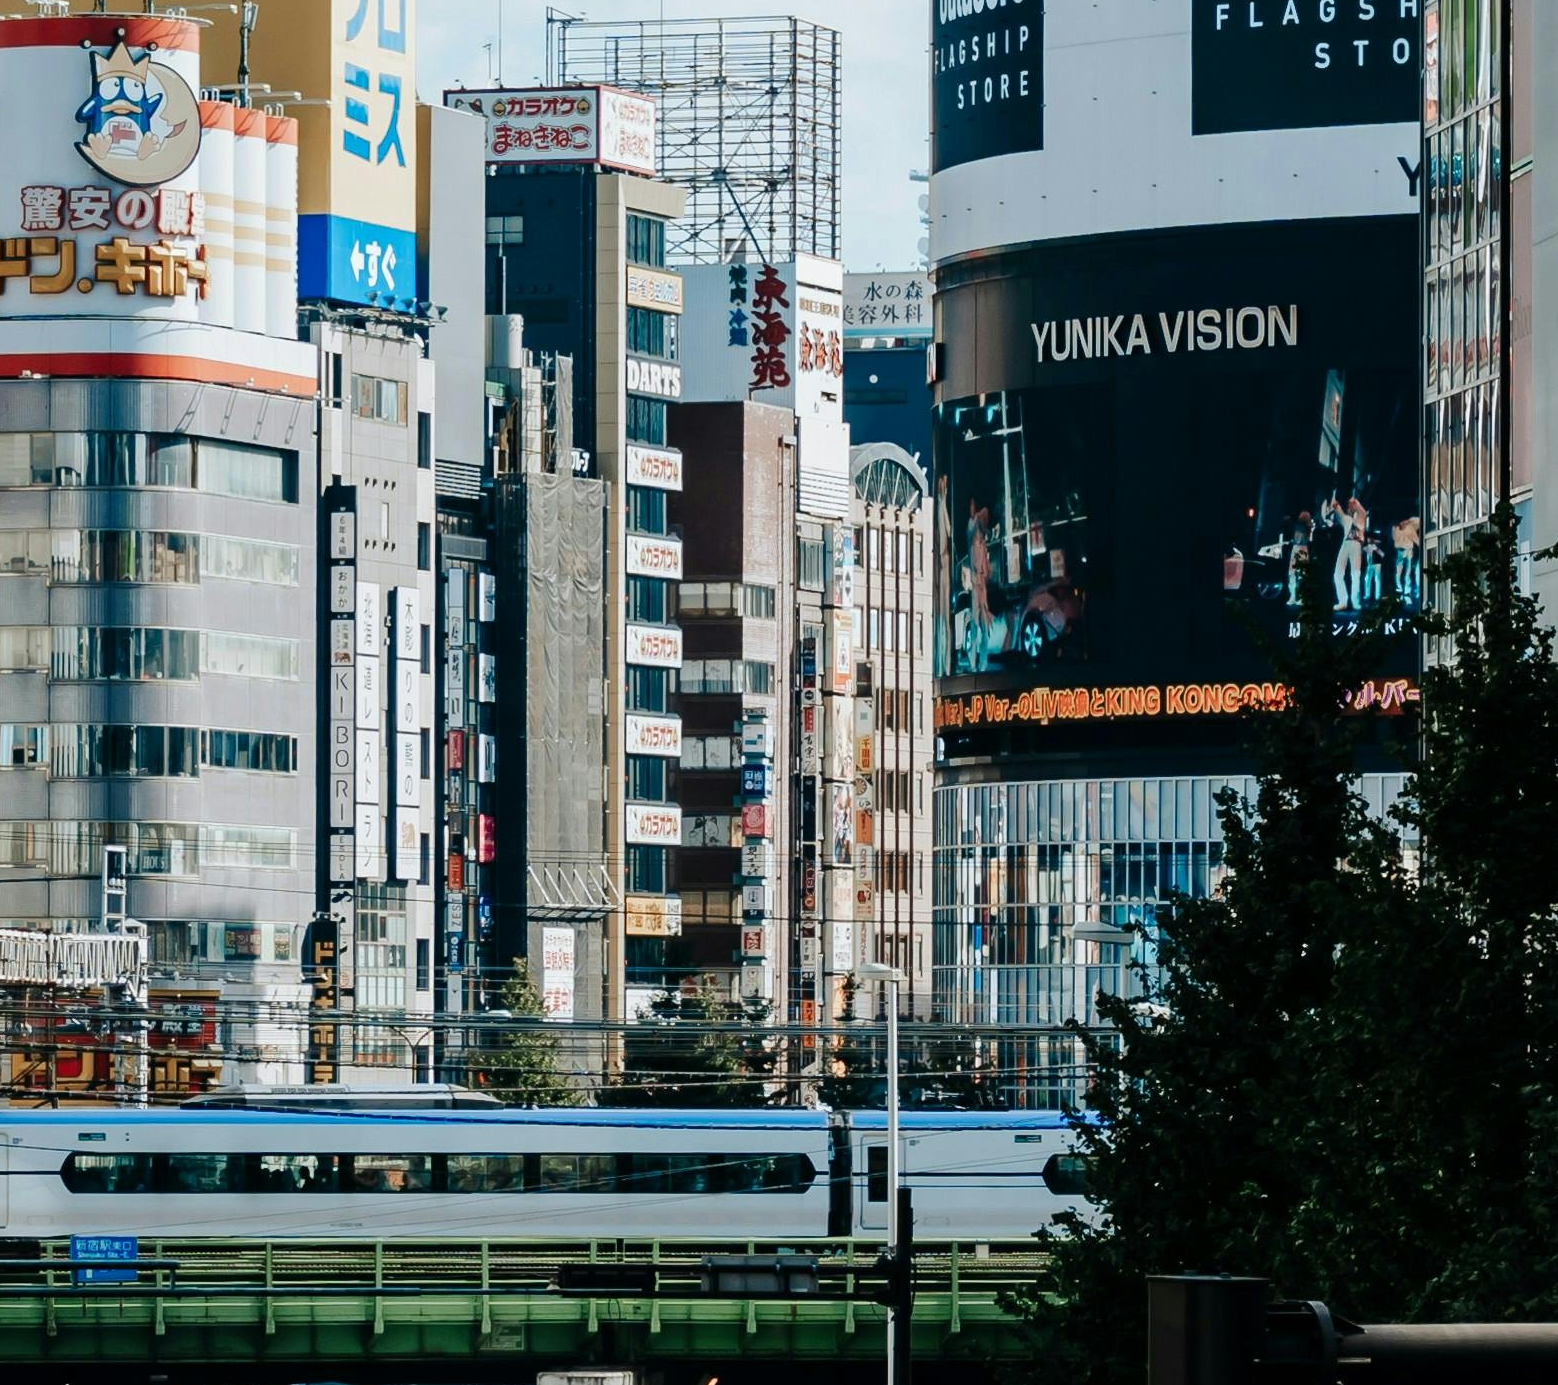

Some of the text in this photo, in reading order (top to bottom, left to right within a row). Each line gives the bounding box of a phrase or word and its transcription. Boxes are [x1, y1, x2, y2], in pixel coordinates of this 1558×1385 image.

[934, 26, 1031, 76] FLAGSHIP
[1314, 37, 1410, 69] STO
[506, 97, 577, 117] カラオケ
[956, 75, 1030, 111] STORE
[343, 63, 406, 168] ミス
[492, 121, 591, 155] まねきねこ
[364, 239, 397, 293] すぐ
[864, 280, 924, 300] 水の森
[749, 263, 792, 388] 東海苑
[843, 305, 924, 325] 美容外科
[1031, 304, 1298, 363] YUNIKA VISION
[626, 358, 682, 398] DARTS
[645, 456, 675, 482] カラオケ
[645, 546, 675, 572] カラオケ
[337, 571, 348, 609] おかか
[645, 635, 675, 661] カラオケ
[334, 672, 350, 822] KIBORI
[645, 726, 675, 751] カラオケ
[645, 816, 675, 841] カラオケ
[75, 1238, 132, 1251] 新宿駅東口
